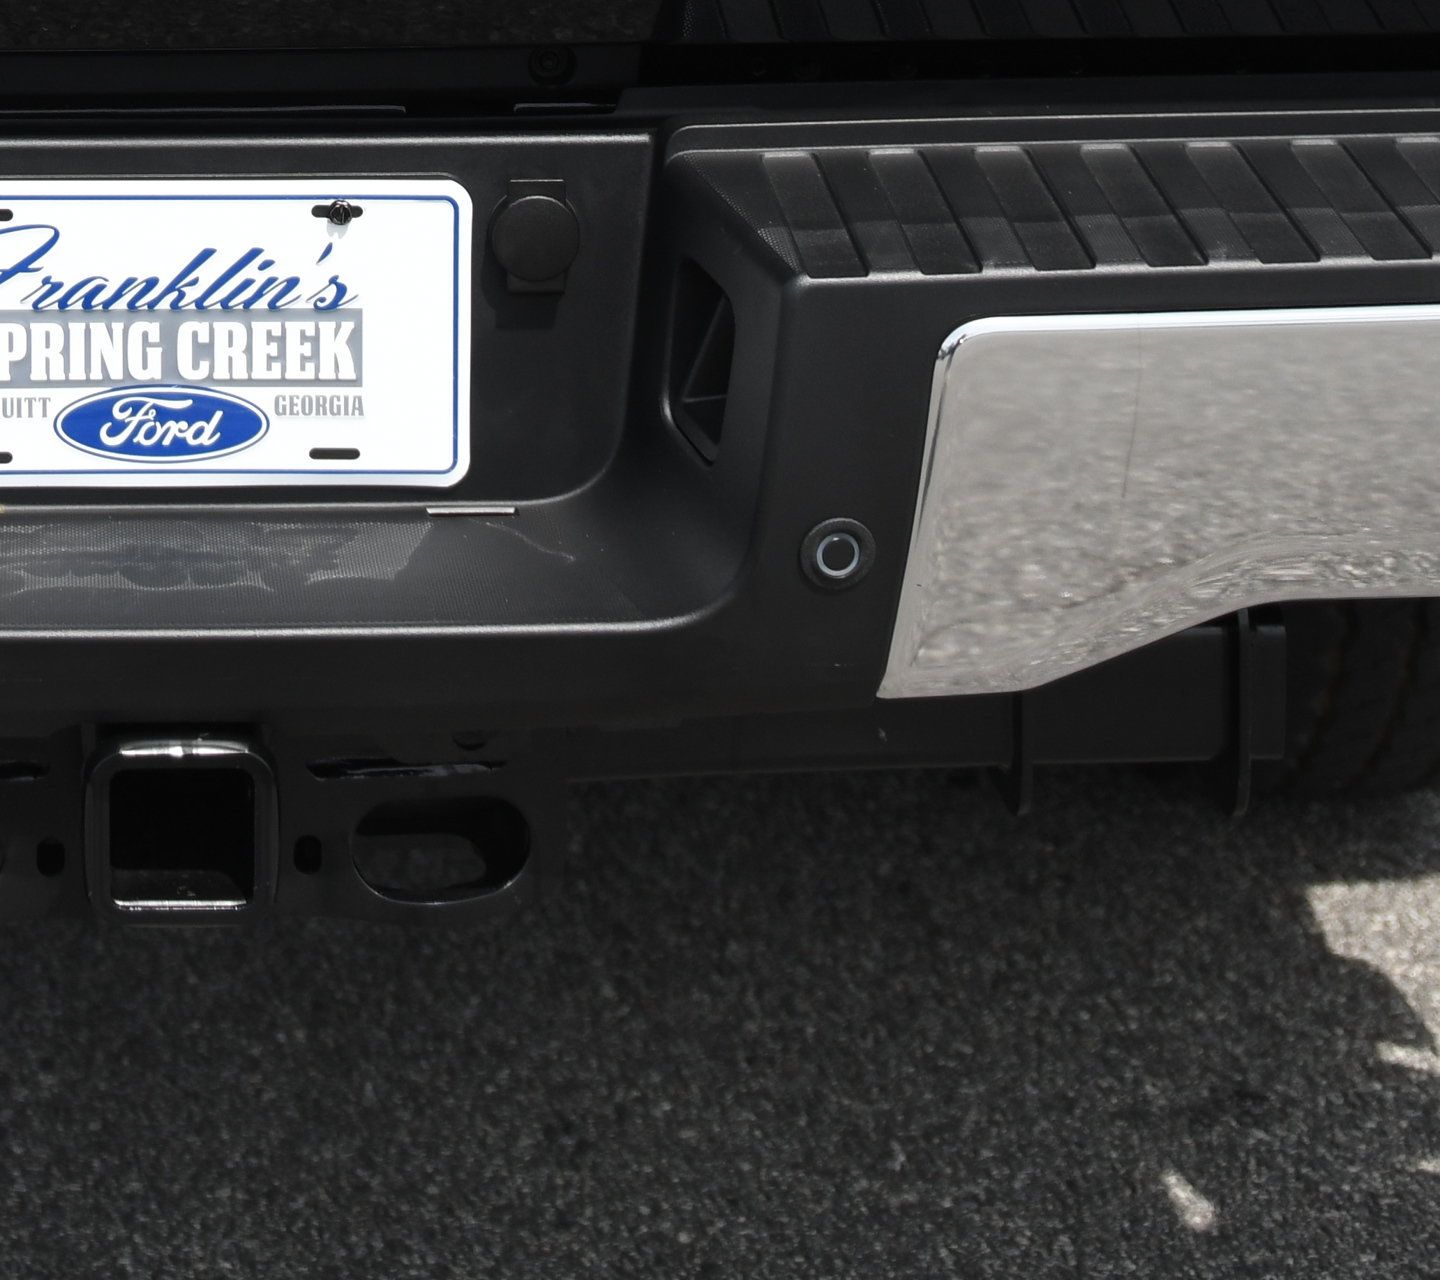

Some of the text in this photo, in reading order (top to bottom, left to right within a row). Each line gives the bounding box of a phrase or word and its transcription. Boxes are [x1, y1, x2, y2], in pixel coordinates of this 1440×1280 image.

[176, 319, 358, 382] CREEK
[99, 396, 224, 449] Ford
[274, 393, 365, 418] GEORGIA
